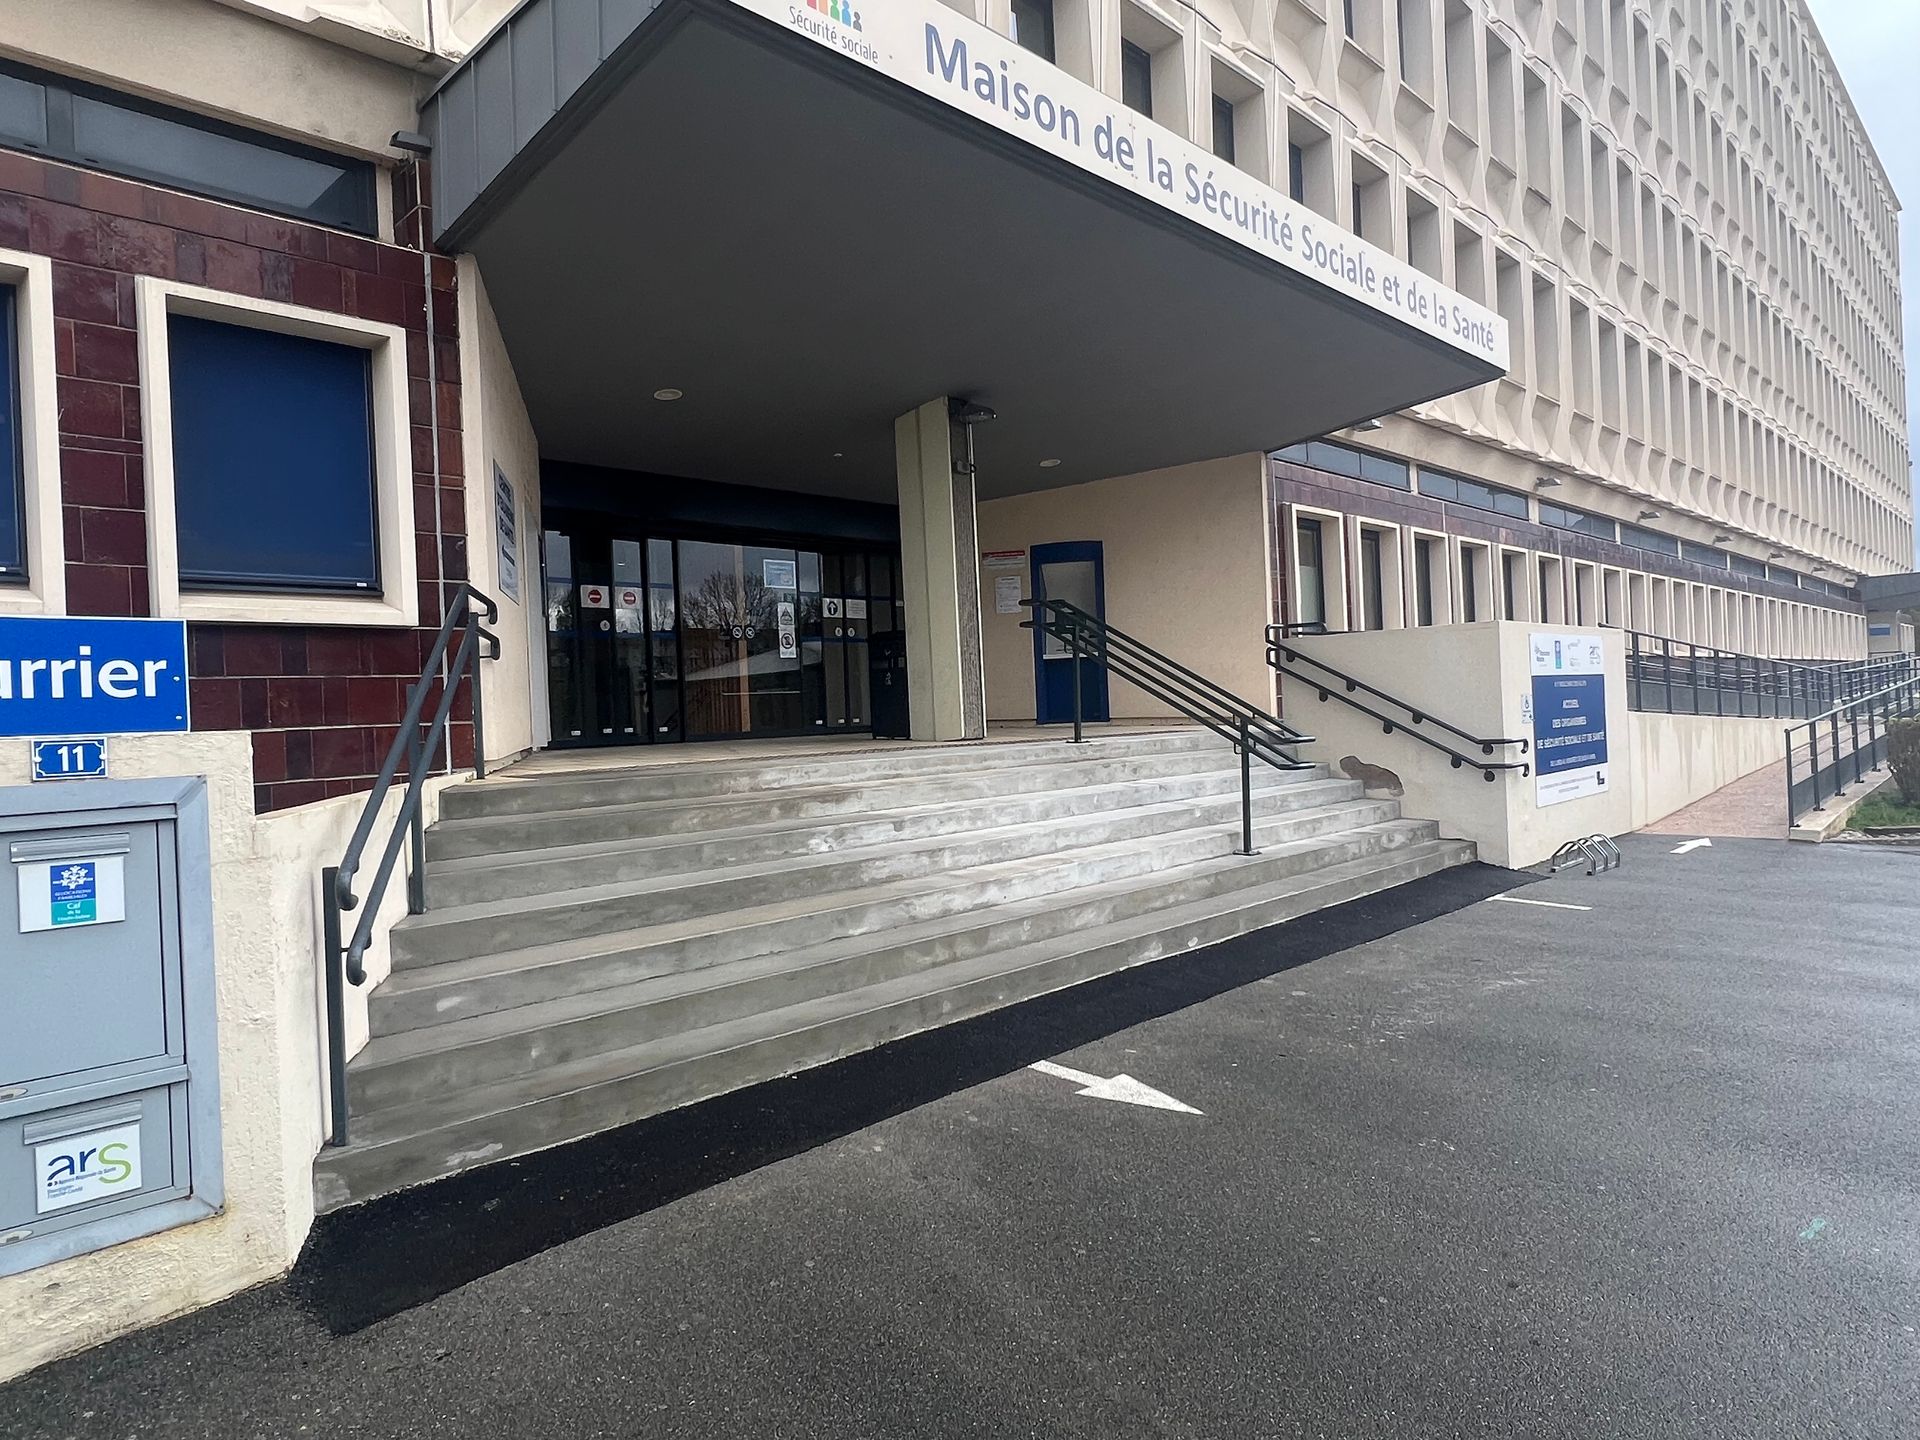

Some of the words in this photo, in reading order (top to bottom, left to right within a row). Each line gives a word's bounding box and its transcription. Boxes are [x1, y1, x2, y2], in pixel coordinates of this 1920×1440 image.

[789, 5, 838, 45] Sécurité
[841, 35, 879, 64] sociale
[925, 22, 1080, 147] Maison
[1094, 115, 1134, 172] de
[1147, 138, 1174, 193] la
[1184, 162, 1293, 252] Sécurité
[1301, 224, 1376, 293] Sociale
[1383, 276, 1401, 306] et
[1407, 282, 1428, 319] de
[1433, 293, 1447, 328] la
[1452, 305, 1494, 352] Santé
[57, 745, 84, 772] 11
